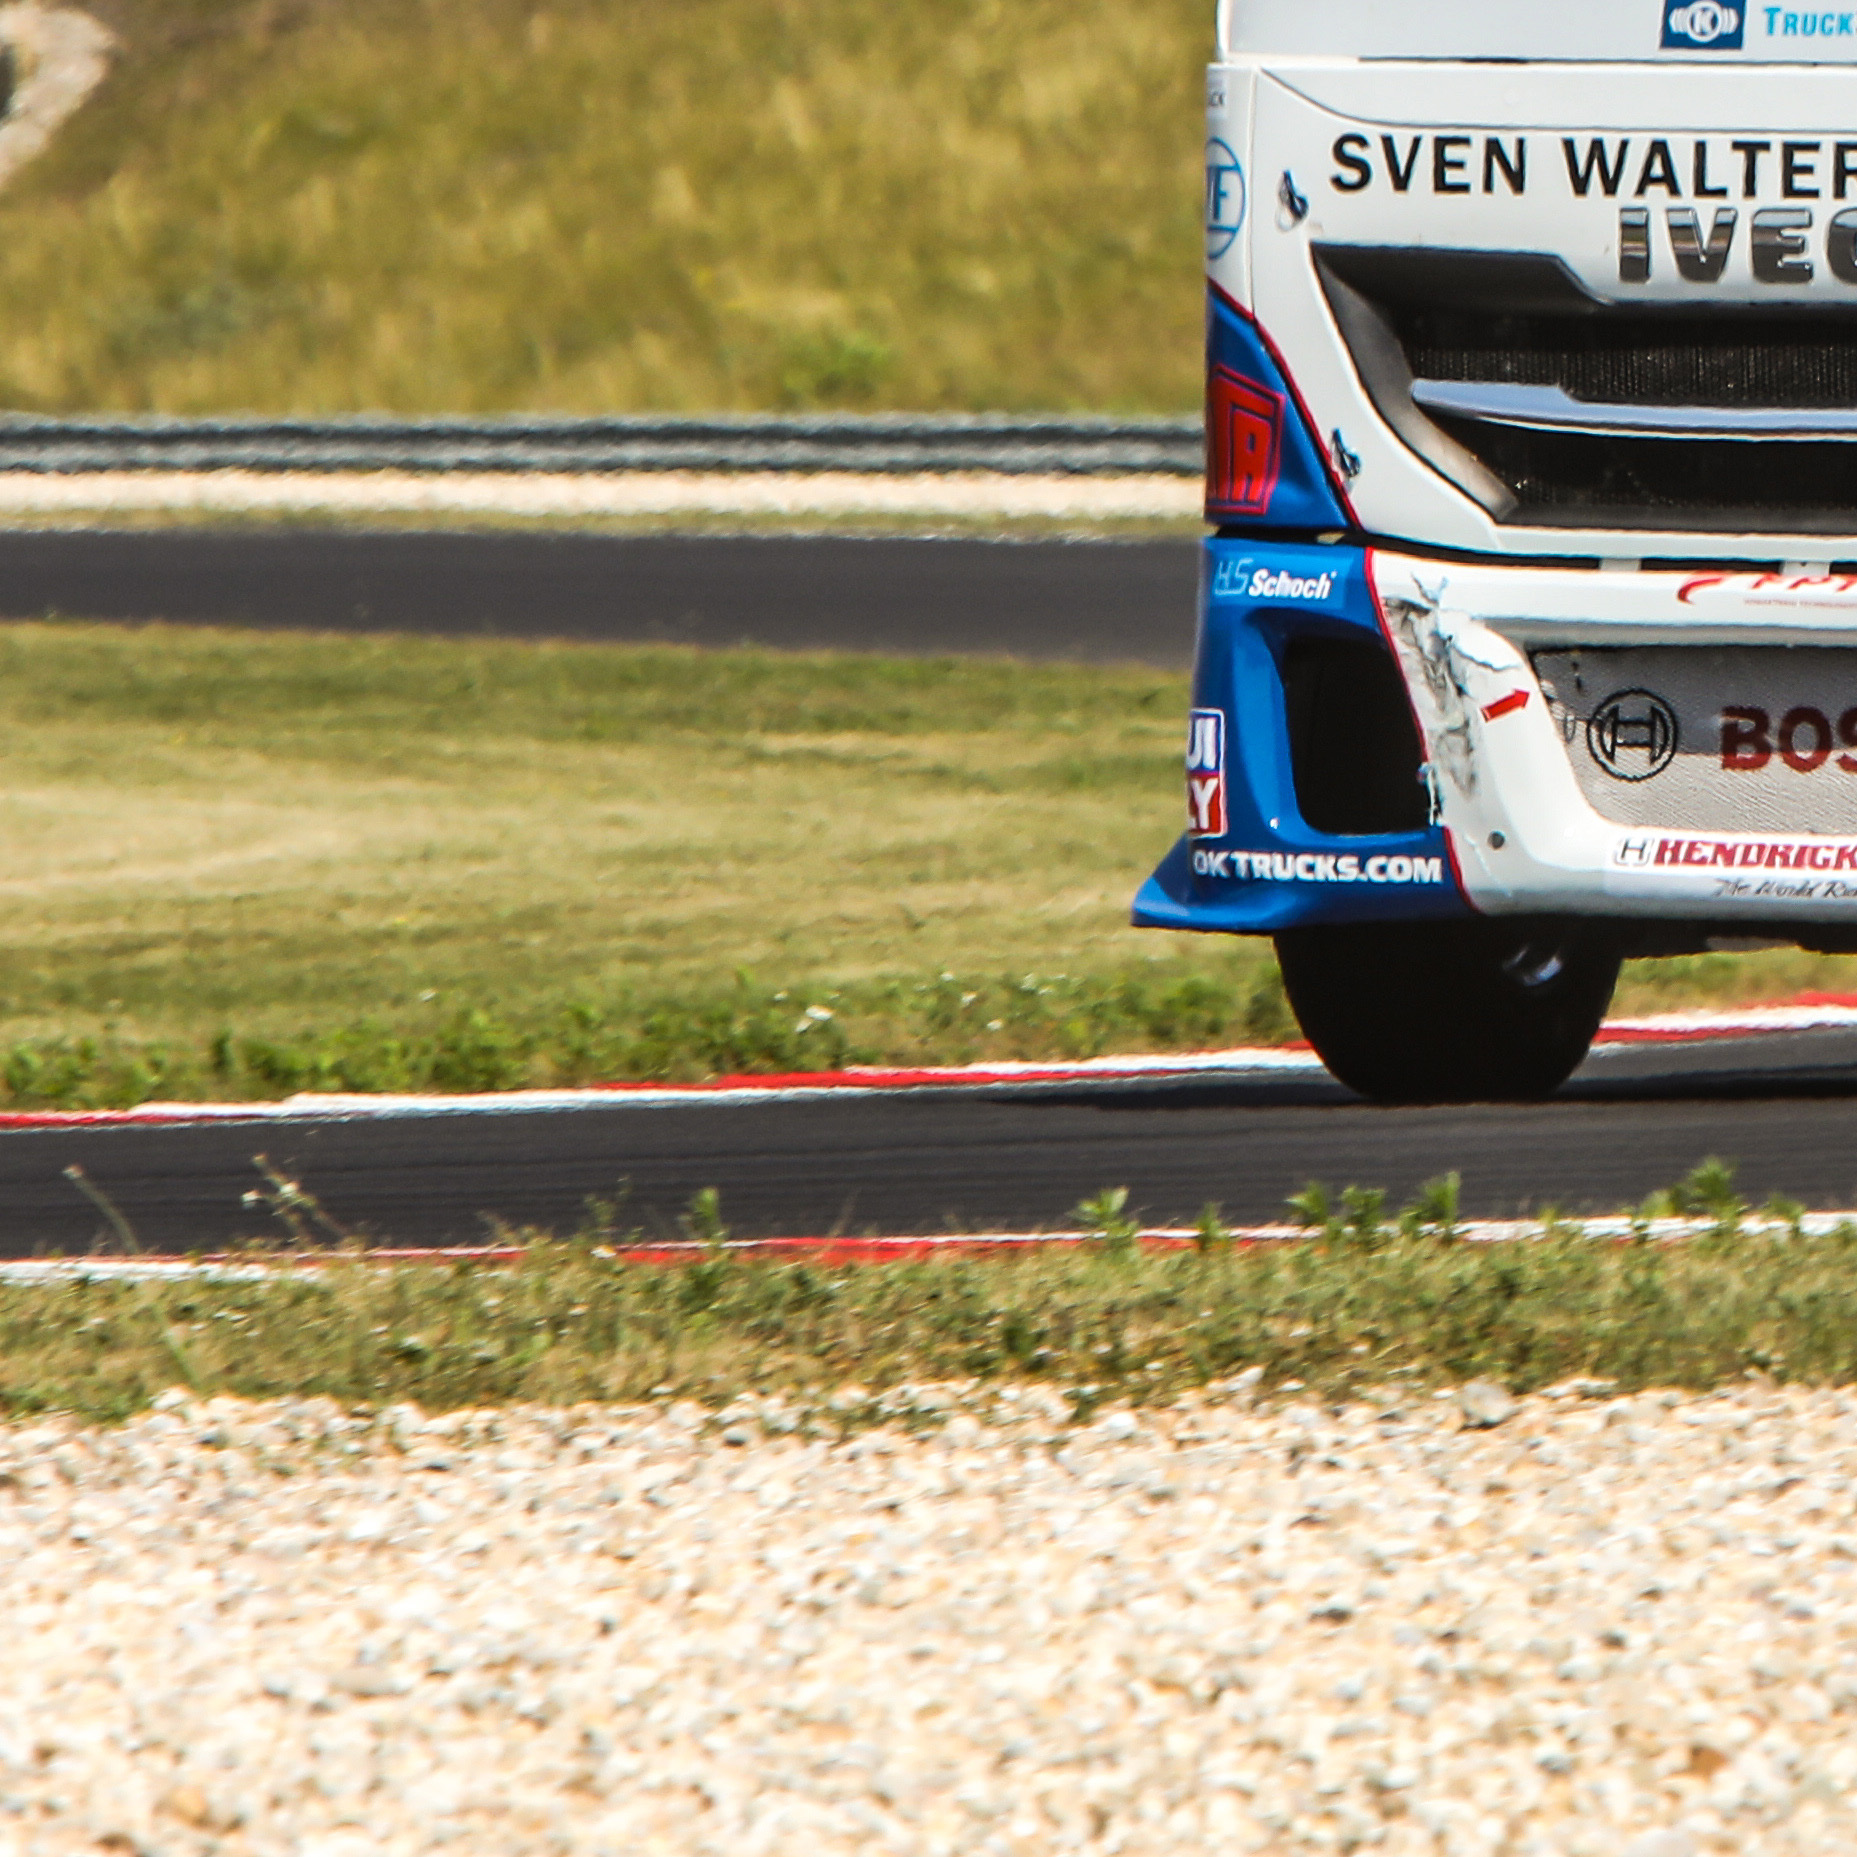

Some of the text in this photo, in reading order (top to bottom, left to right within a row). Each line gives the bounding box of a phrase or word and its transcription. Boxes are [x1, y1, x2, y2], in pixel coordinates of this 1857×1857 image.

[1330, 132, 1527, 196] SVEN
[1248, 567, 1336, 600] Schoch
[1194, 848, 1445, 884] OK TRUCKS.COM
